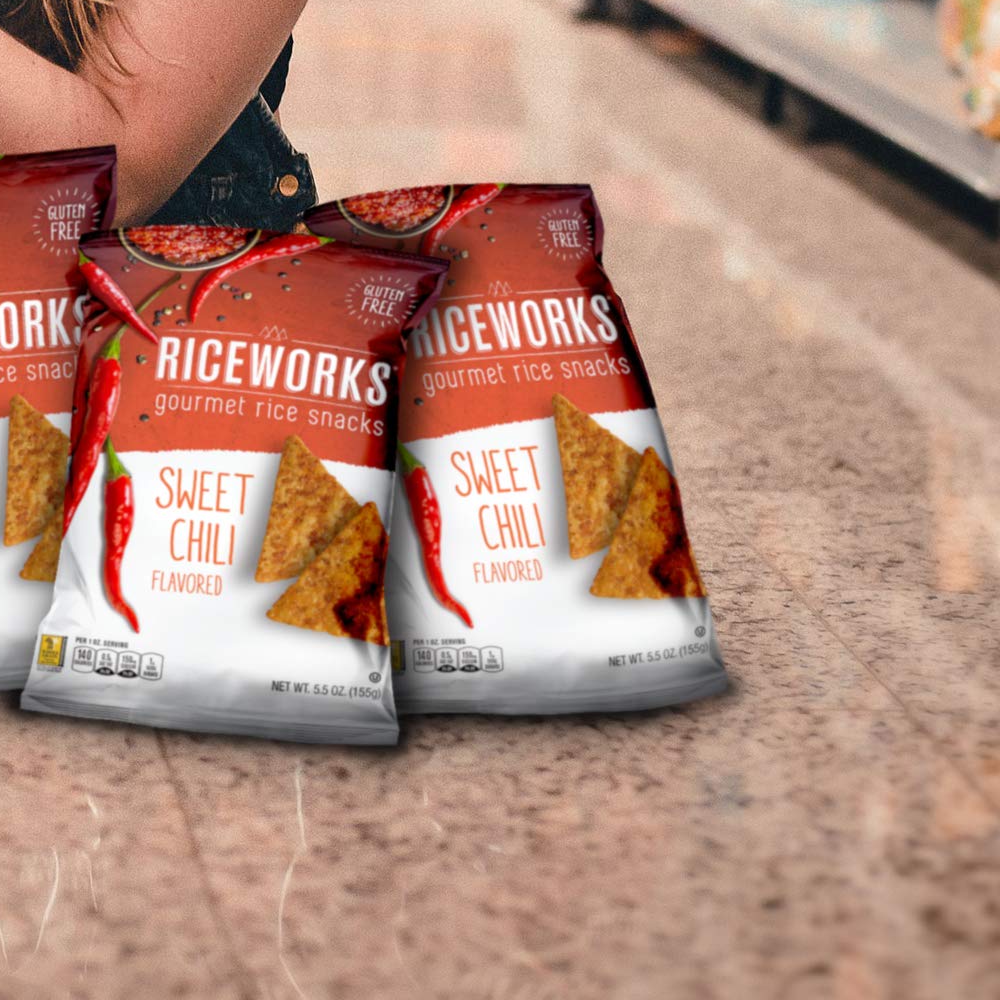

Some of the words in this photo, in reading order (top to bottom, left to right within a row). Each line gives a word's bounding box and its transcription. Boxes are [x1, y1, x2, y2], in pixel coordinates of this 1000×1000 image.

[48, 203, 86, 220] GLUTEN
[50, 220, 81, 241] FREE
[548, 219, 579, 231] GLUTEN
[552, 232, 581, 248] FREE
[363, 284, 405, 302] GLUTEN
[361, 297, 397, 317] FREE
[410, 294, 619, 359] RICEWORKS
[155, 335, 391, 406] RICEWORKS
[423, 362, 506, 397] gourmet
[513, 359, 554, 384] rice
[561, 353, 631, 379] snacks
[154, 394, 246, 418] gourmet
[255, 400, 298, 422] rice
[308, 407, 384, 437] snacks
[451, 445, 541, 497] SWEET
[156, 466, 254, 515] SWEET
[478, 502, 547, 550] CHILI
[169, 518, 235, 565] CHILI
[151, 570, 223, 596] FLAVORED
[473, 558, 543, 584] FLAVORED
[78, 649, 92, 660] 140
[608, 655, 626, 667] NET
[647, 651, 661, 662] 5.5
[679, 642, 709, 657] (155g)
[271, 680, 290, 692] NET
[293, 682, 310, 694] WT.
[313, 684, 328, 695] 5.5
[331, 685, 346, 697] OZ.
[349, 686, 381, 699] (155g)
